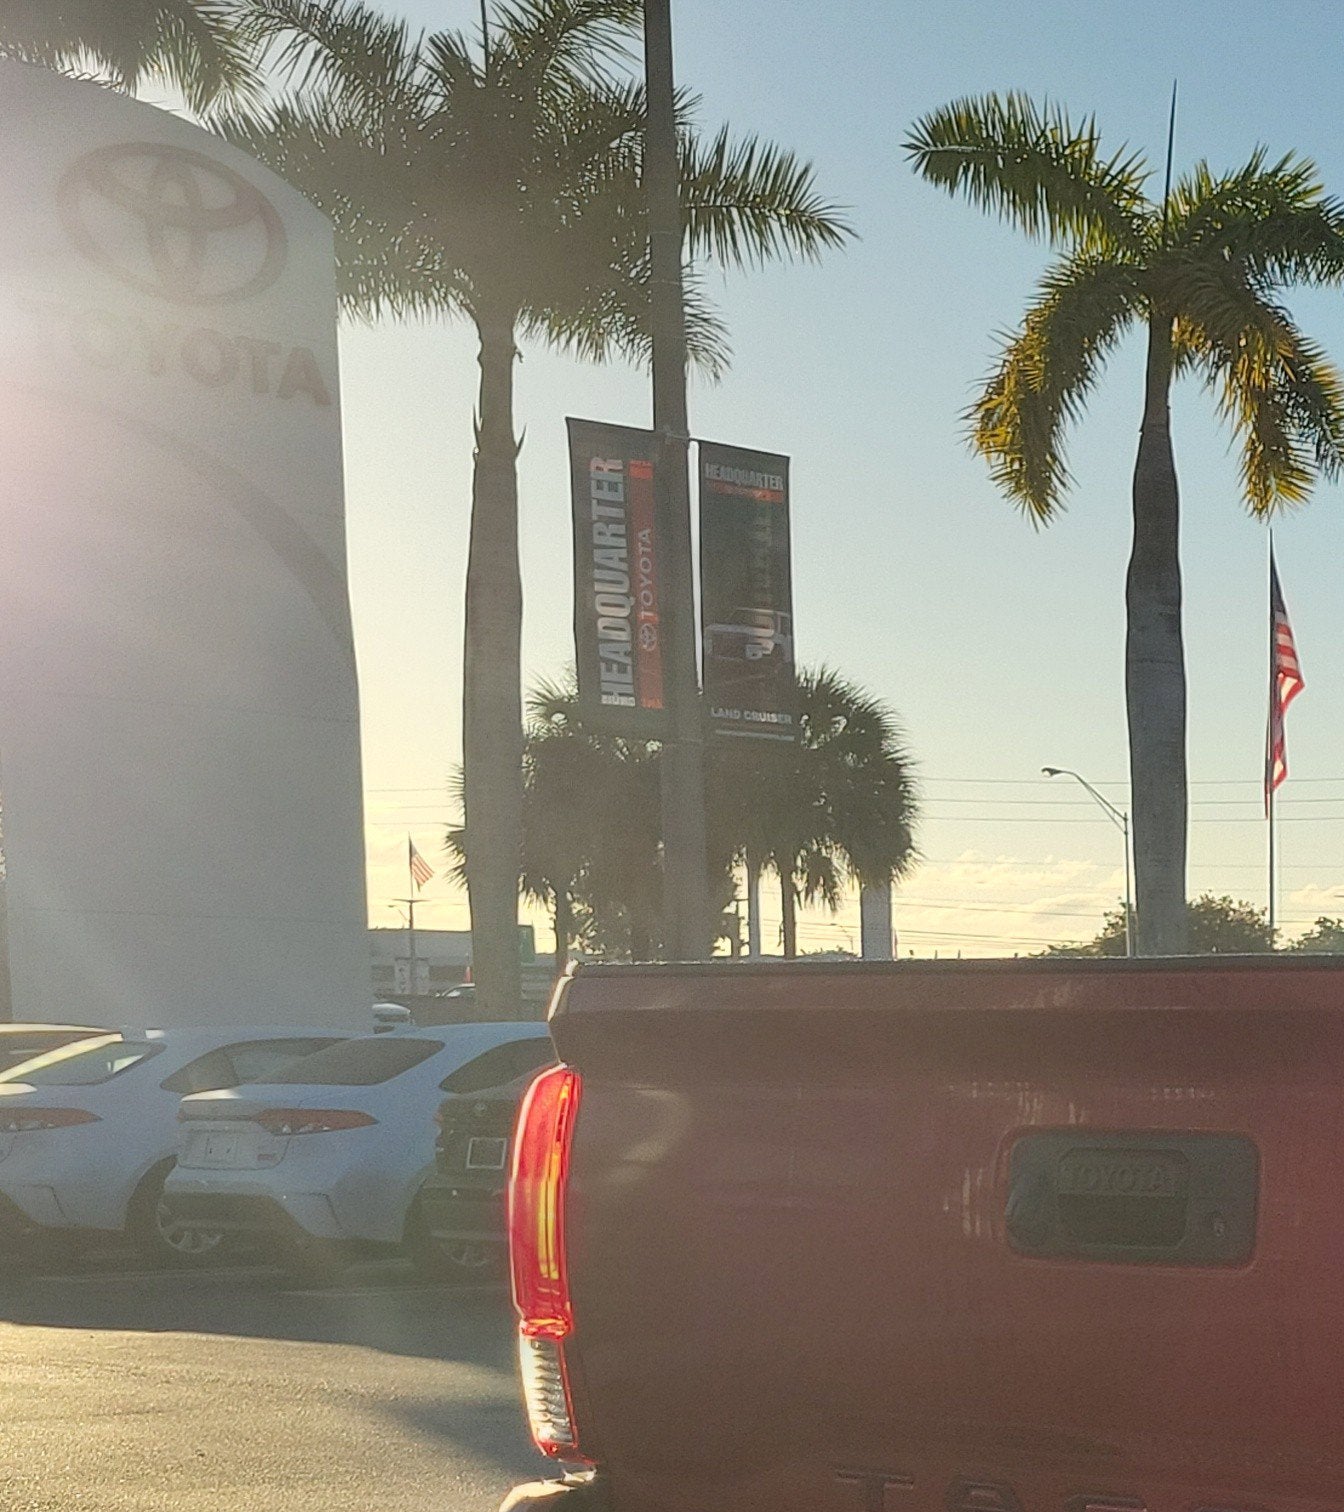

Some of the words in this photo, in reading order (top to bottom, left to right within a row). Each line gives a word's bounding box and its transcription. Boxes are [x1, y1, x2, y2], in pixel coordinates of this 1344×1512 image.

[24, 292, 332, 408] TOYOTA
[704, 462, 784, 490] HEADQUARTER
[589, 456, 635, 707] HEADQUARTER
[637, 527, 654, 620] TOYOTA
[743, 710, 792, 724] CRUISER
